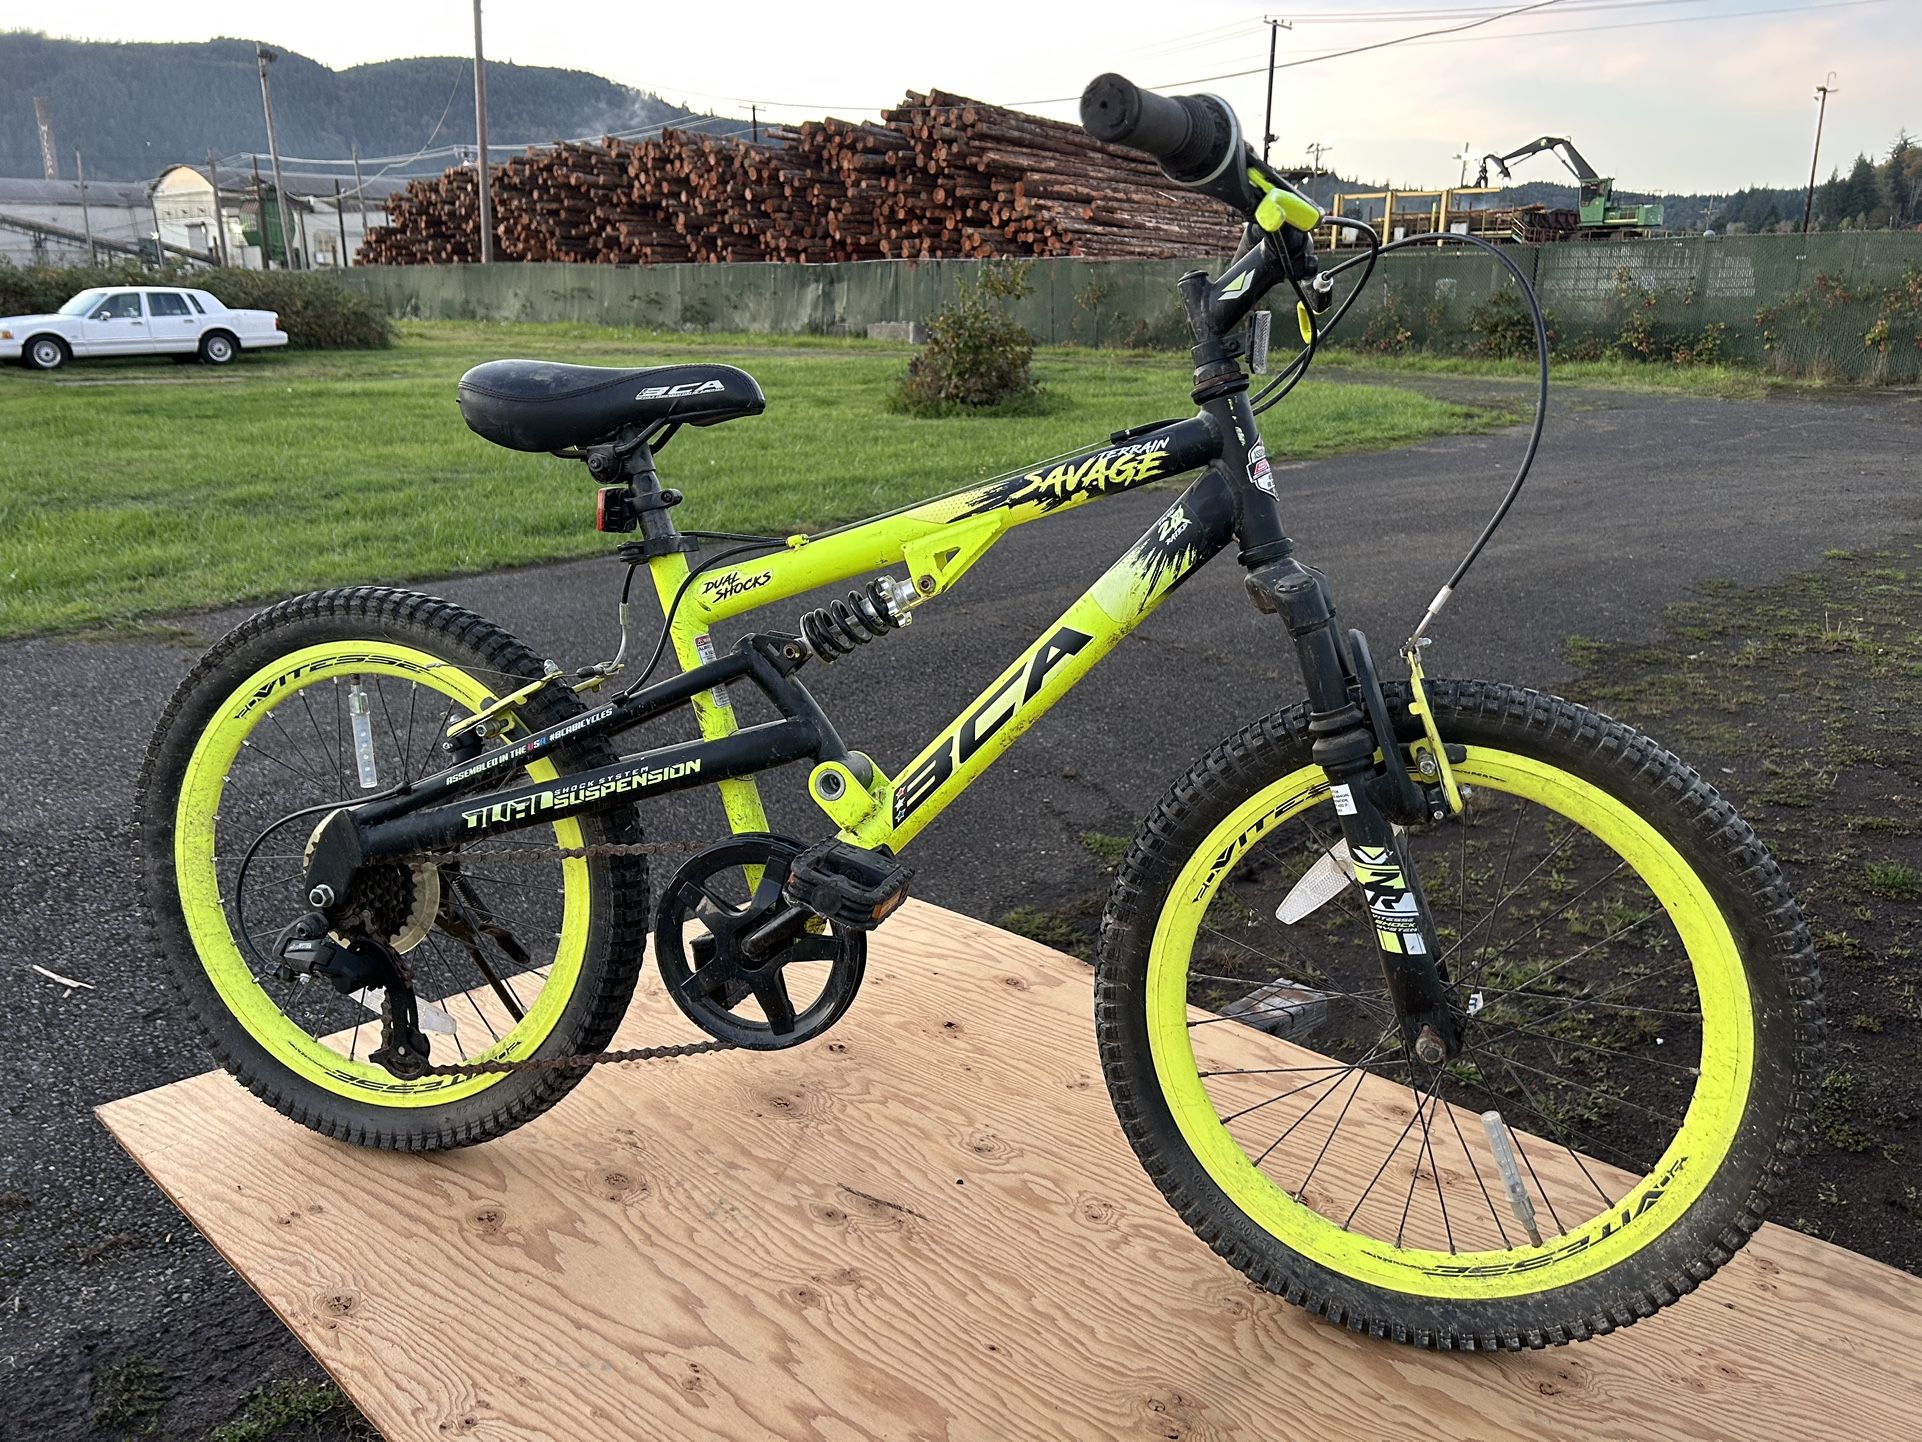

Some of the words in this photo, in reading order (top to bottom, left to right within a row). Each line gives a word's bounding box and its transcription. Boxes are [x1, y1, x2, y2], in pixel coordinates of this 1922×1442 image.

[635, 379, 725, 400] BCA
[1094, 437, 1170, 460] TERRAIN
[1008, 450, 1170, 498] SAVAGE
[702, 572, 741, 595] DUAL
[712, 571, 772, 603] SHOCKS
[253, 654, 431, 701] VITESSE
[446, 758, 498, 786] ASSEMBLED
[498, 753, 509, 765] IN
[510, 746, 527, 759] THE
[527, 736, 548, 752] USA
[549, 707, 613, 742] #BCABICYCLES
[892, 626, 1094, 830] BCA
[553, 758, 701, 809] SUSPENSION
[554, 780, 594, 796] SHOCK
[598, 765, 649, 785] SYSTEM
[1375, 919, 1416, 928] SHOCK
[1422, 1190, 1666, 1278] VITESSE
